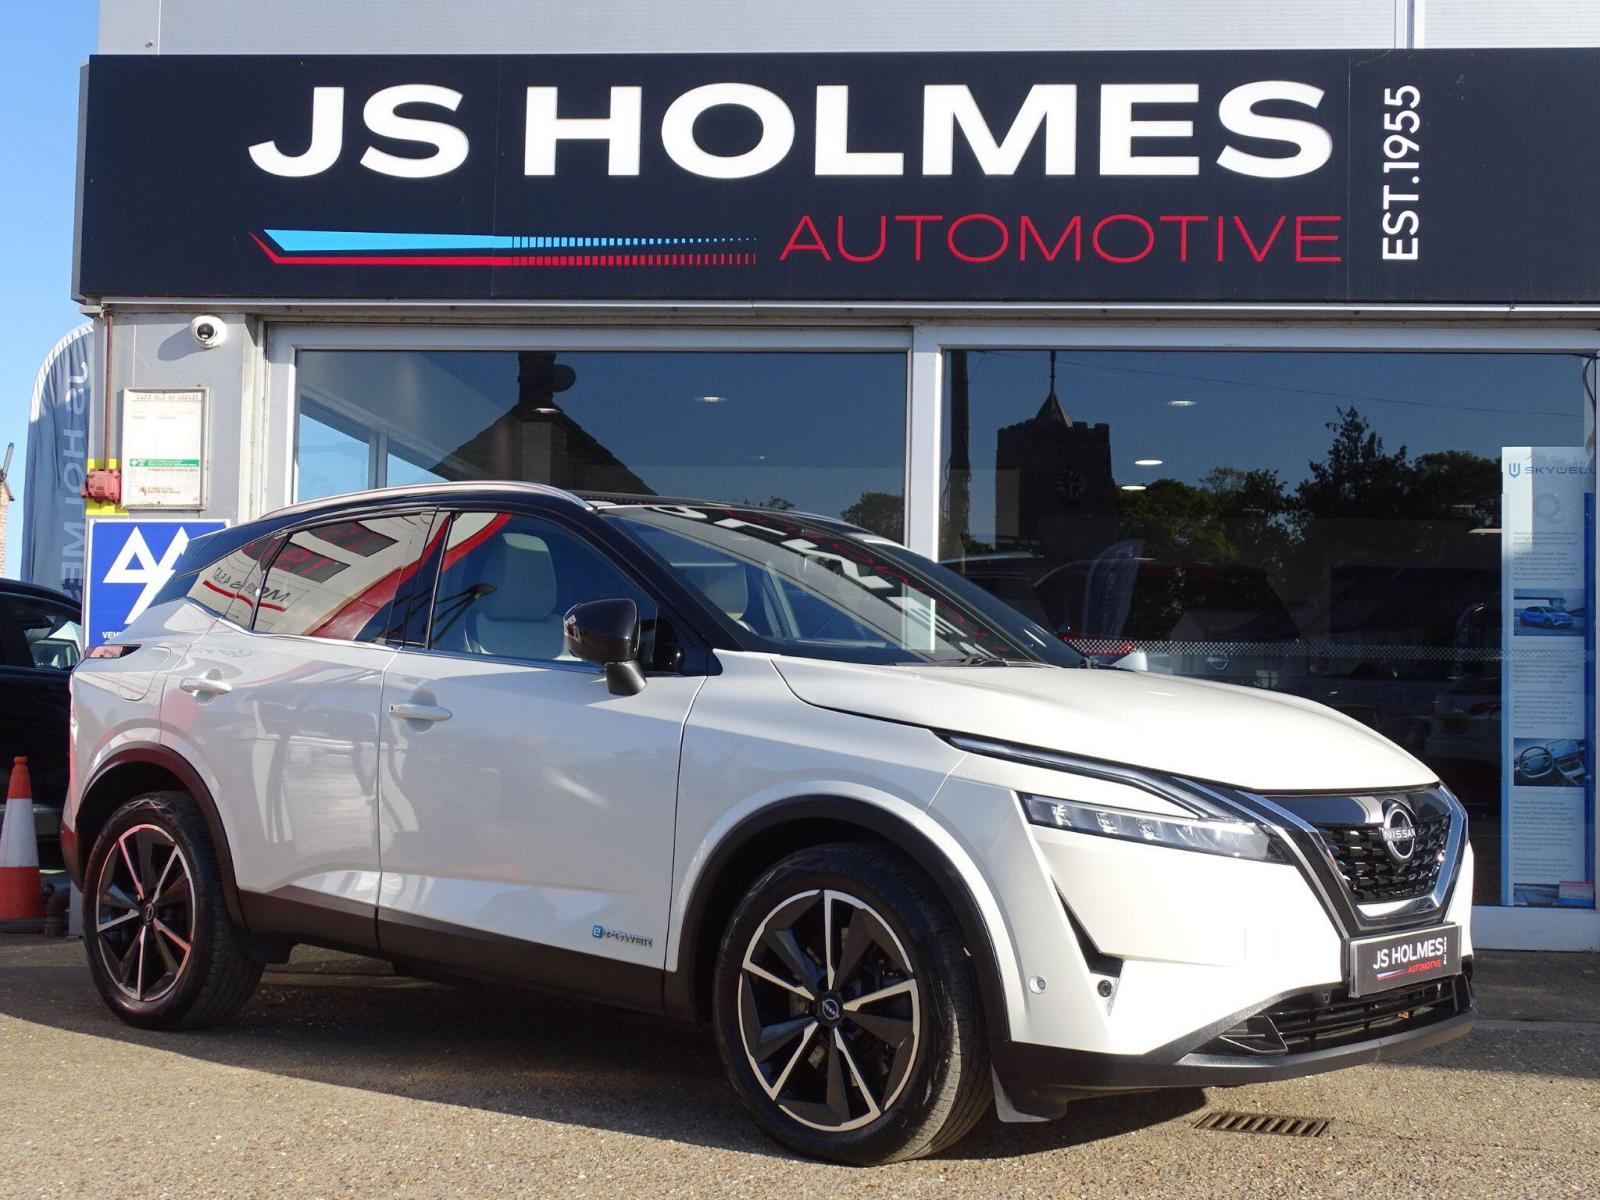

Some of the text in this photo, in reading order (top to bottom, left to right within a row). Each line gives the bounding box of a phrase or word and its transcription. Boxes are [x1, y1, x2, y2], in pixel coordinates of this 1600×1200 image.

[248, 80, 1334, 180] JS HOLMES
[779, 213, 1342, 264] AUTOMOTIVE
[1383, 828, 1416, 840] NISSAN
[1373, 948, 1389, 970] JS
[1392, 937, 1444, 965] HOLMES
[1407, 959, 1442, 973] AUTOMOTIVE
